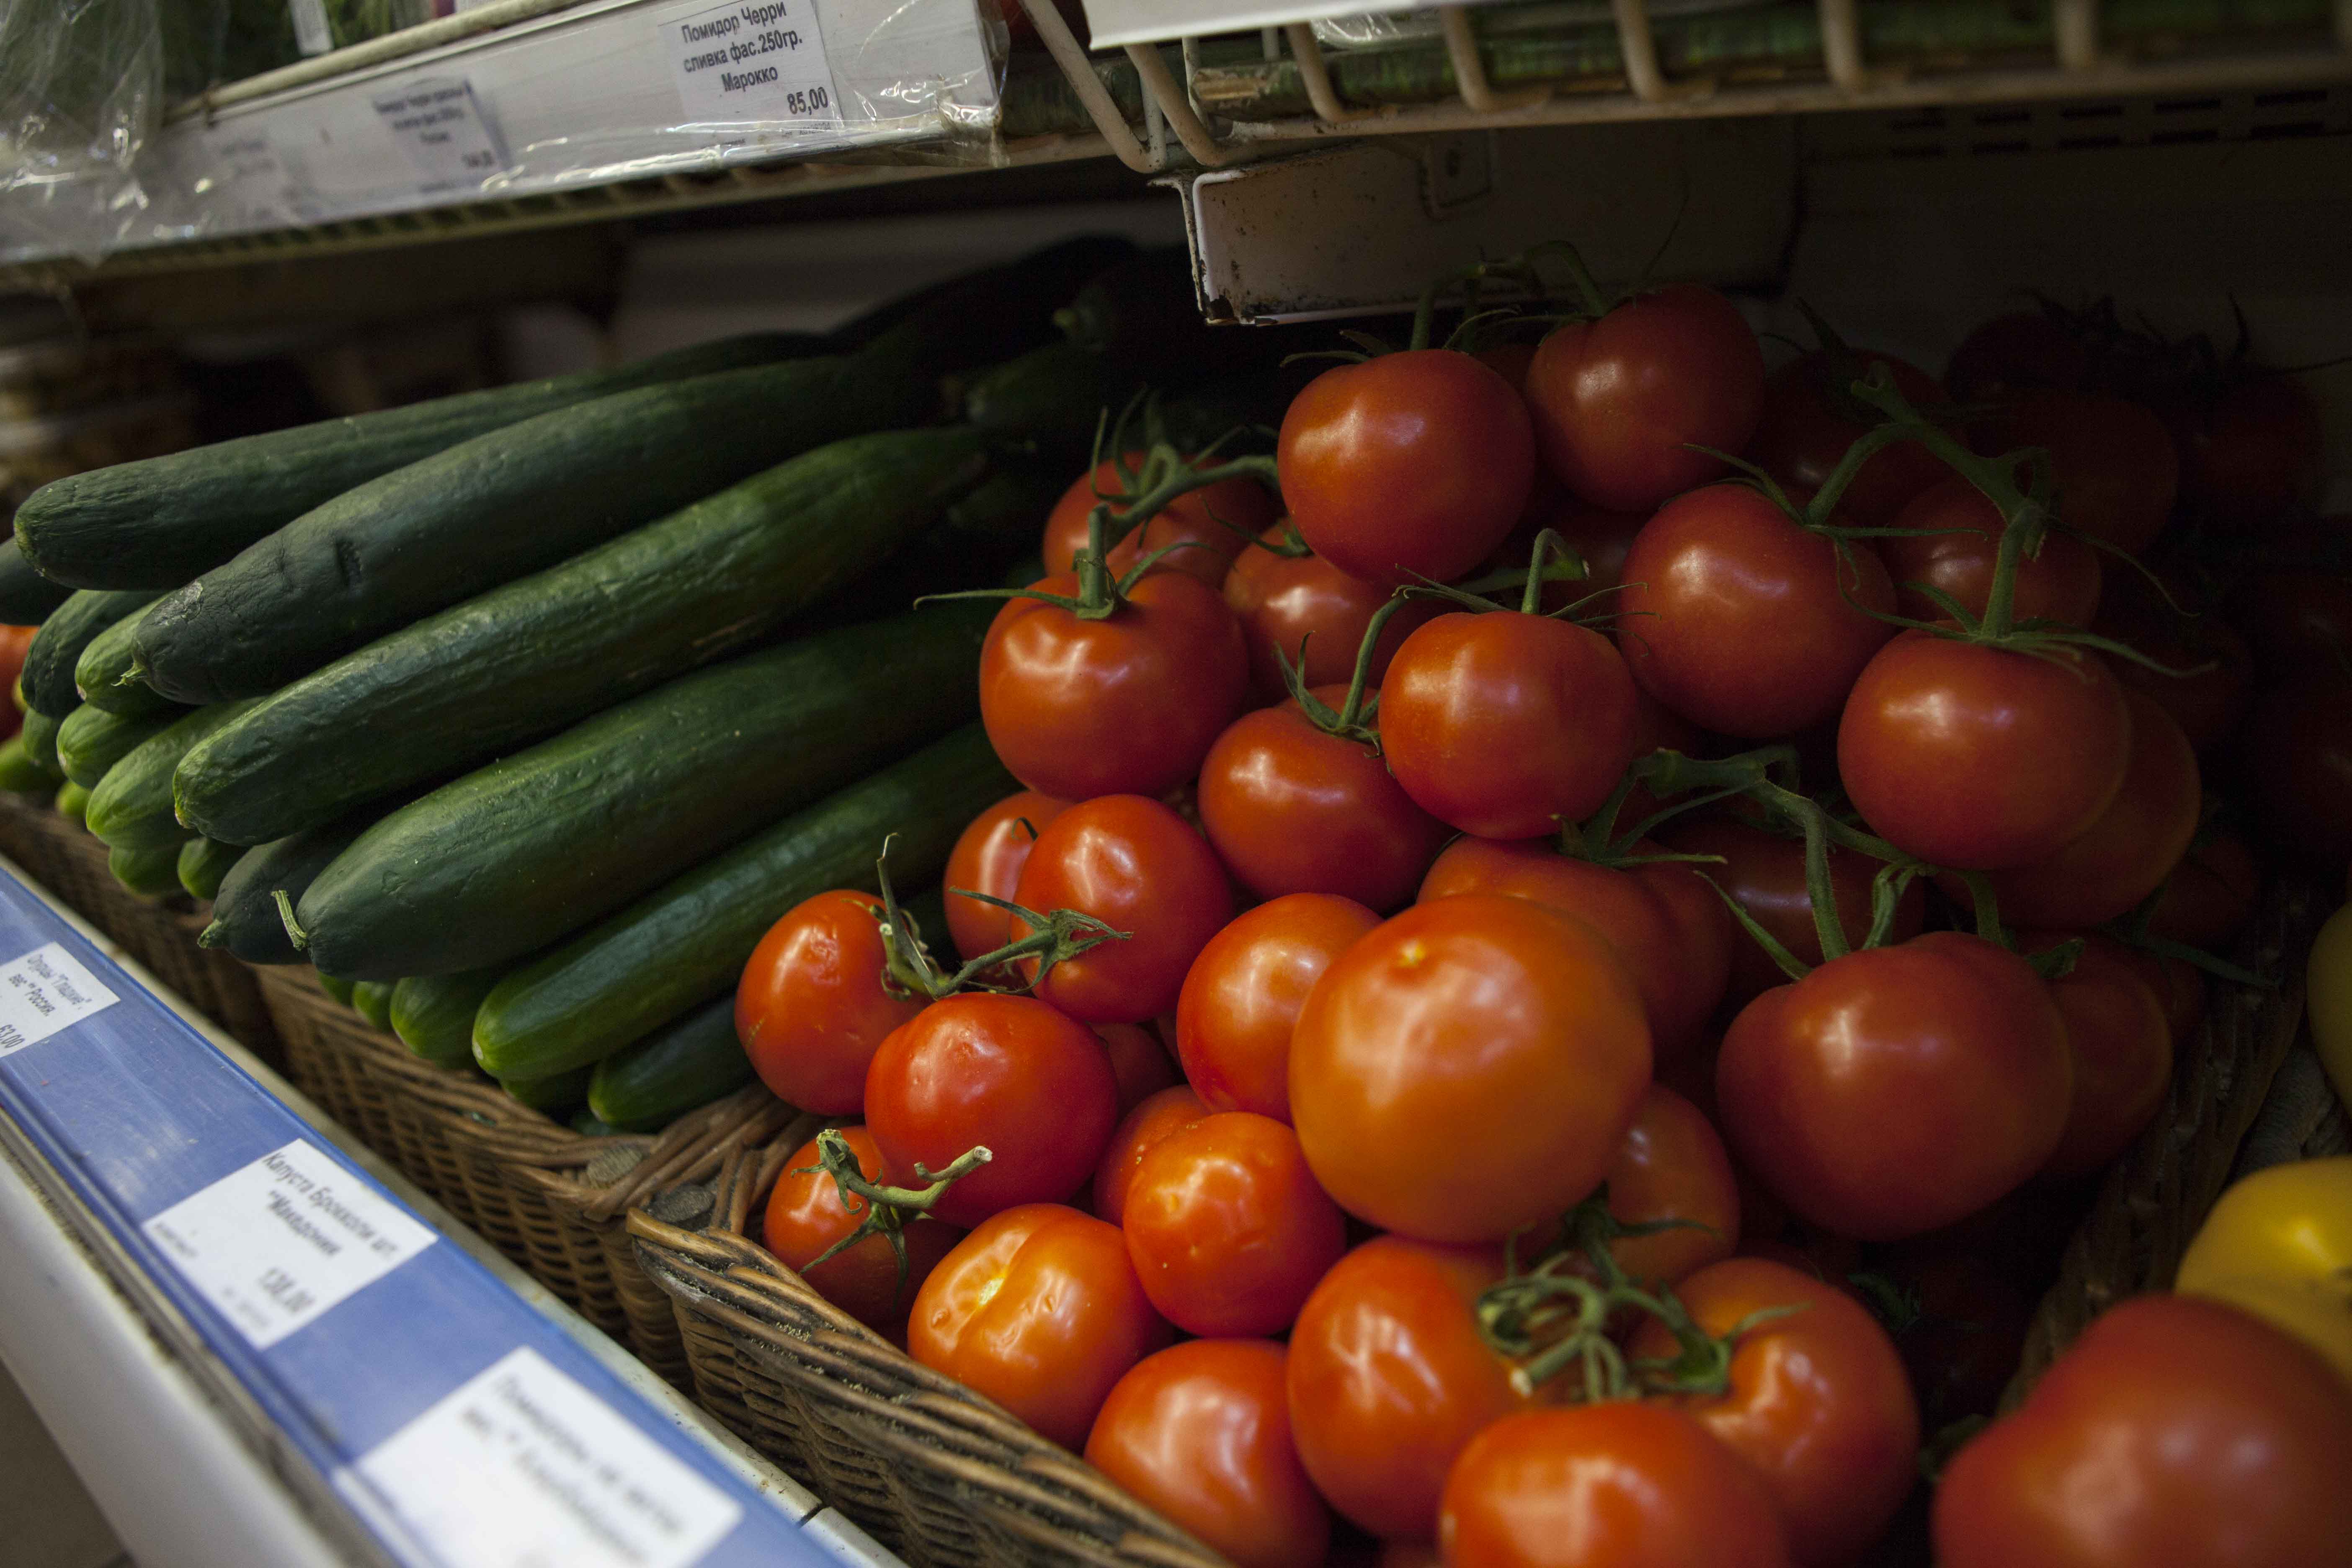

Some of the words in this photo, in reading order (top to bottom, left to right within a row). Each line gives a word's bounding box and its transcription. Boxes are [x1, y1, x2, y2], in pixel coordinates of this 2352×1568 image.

[681, 15, 740, 44] Помидор
[741, 1, 787, 27] Черри
[683, 49, 728, 72] сливка
[730, 30, 802, 64] фас.250гр.
[721, 66, 778, 92] Марокко
[787, 87, 828, 115] 85,00
[262, 1152, 315, 1194] Капуста
